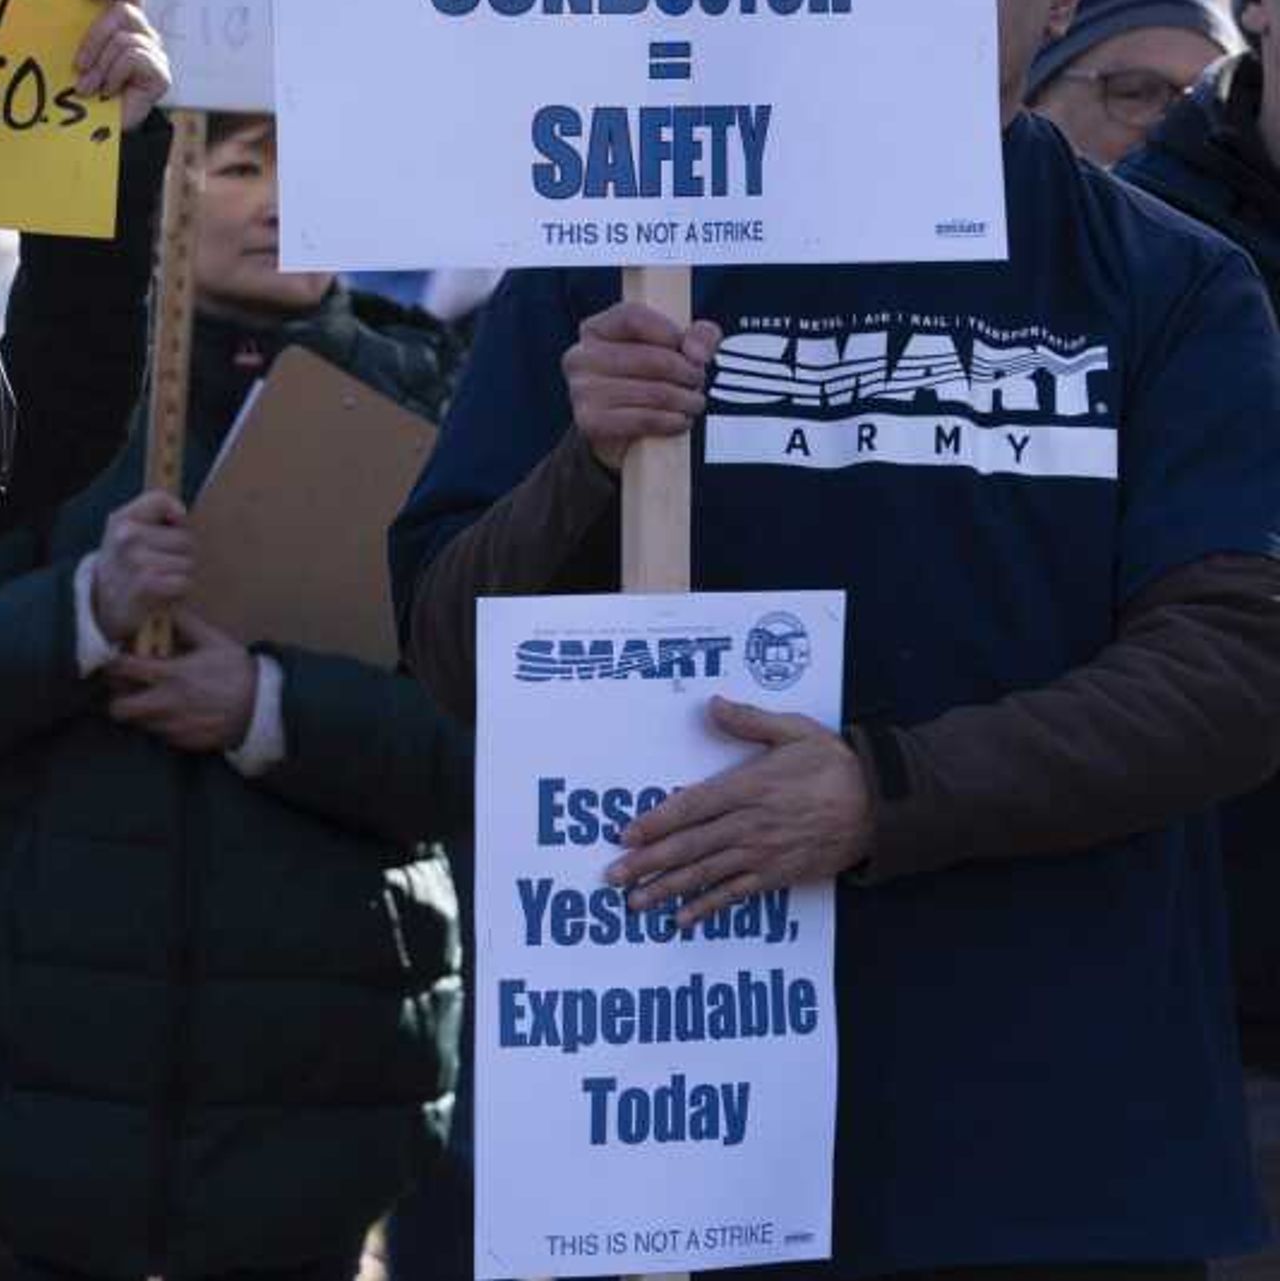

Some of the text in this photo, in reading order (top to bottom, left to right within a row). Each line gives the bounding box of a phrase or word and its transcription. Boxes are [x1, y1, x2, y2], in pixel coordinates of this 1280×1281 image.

[532, 104, 772, 200] SAFETY
[542, 221, 763, 245] THIS IS NOT A STRIKE
[707, 331, 1108, 416] SMART
[786, 423, 1030, 463] ARMY
[514, 636, 732, 681] SMART
[498, 968, 818, 1053] Expendable
[583, 1074, 750, 1146] Today
[546, 1235, 598, 1256] THIS
[607, 1232, 627, 1254] IS
[634, 1230, 681, 1253] NOT
[686, 1229, 700, 1250] A
[704, 1223, 773, 1249] STRIKE
